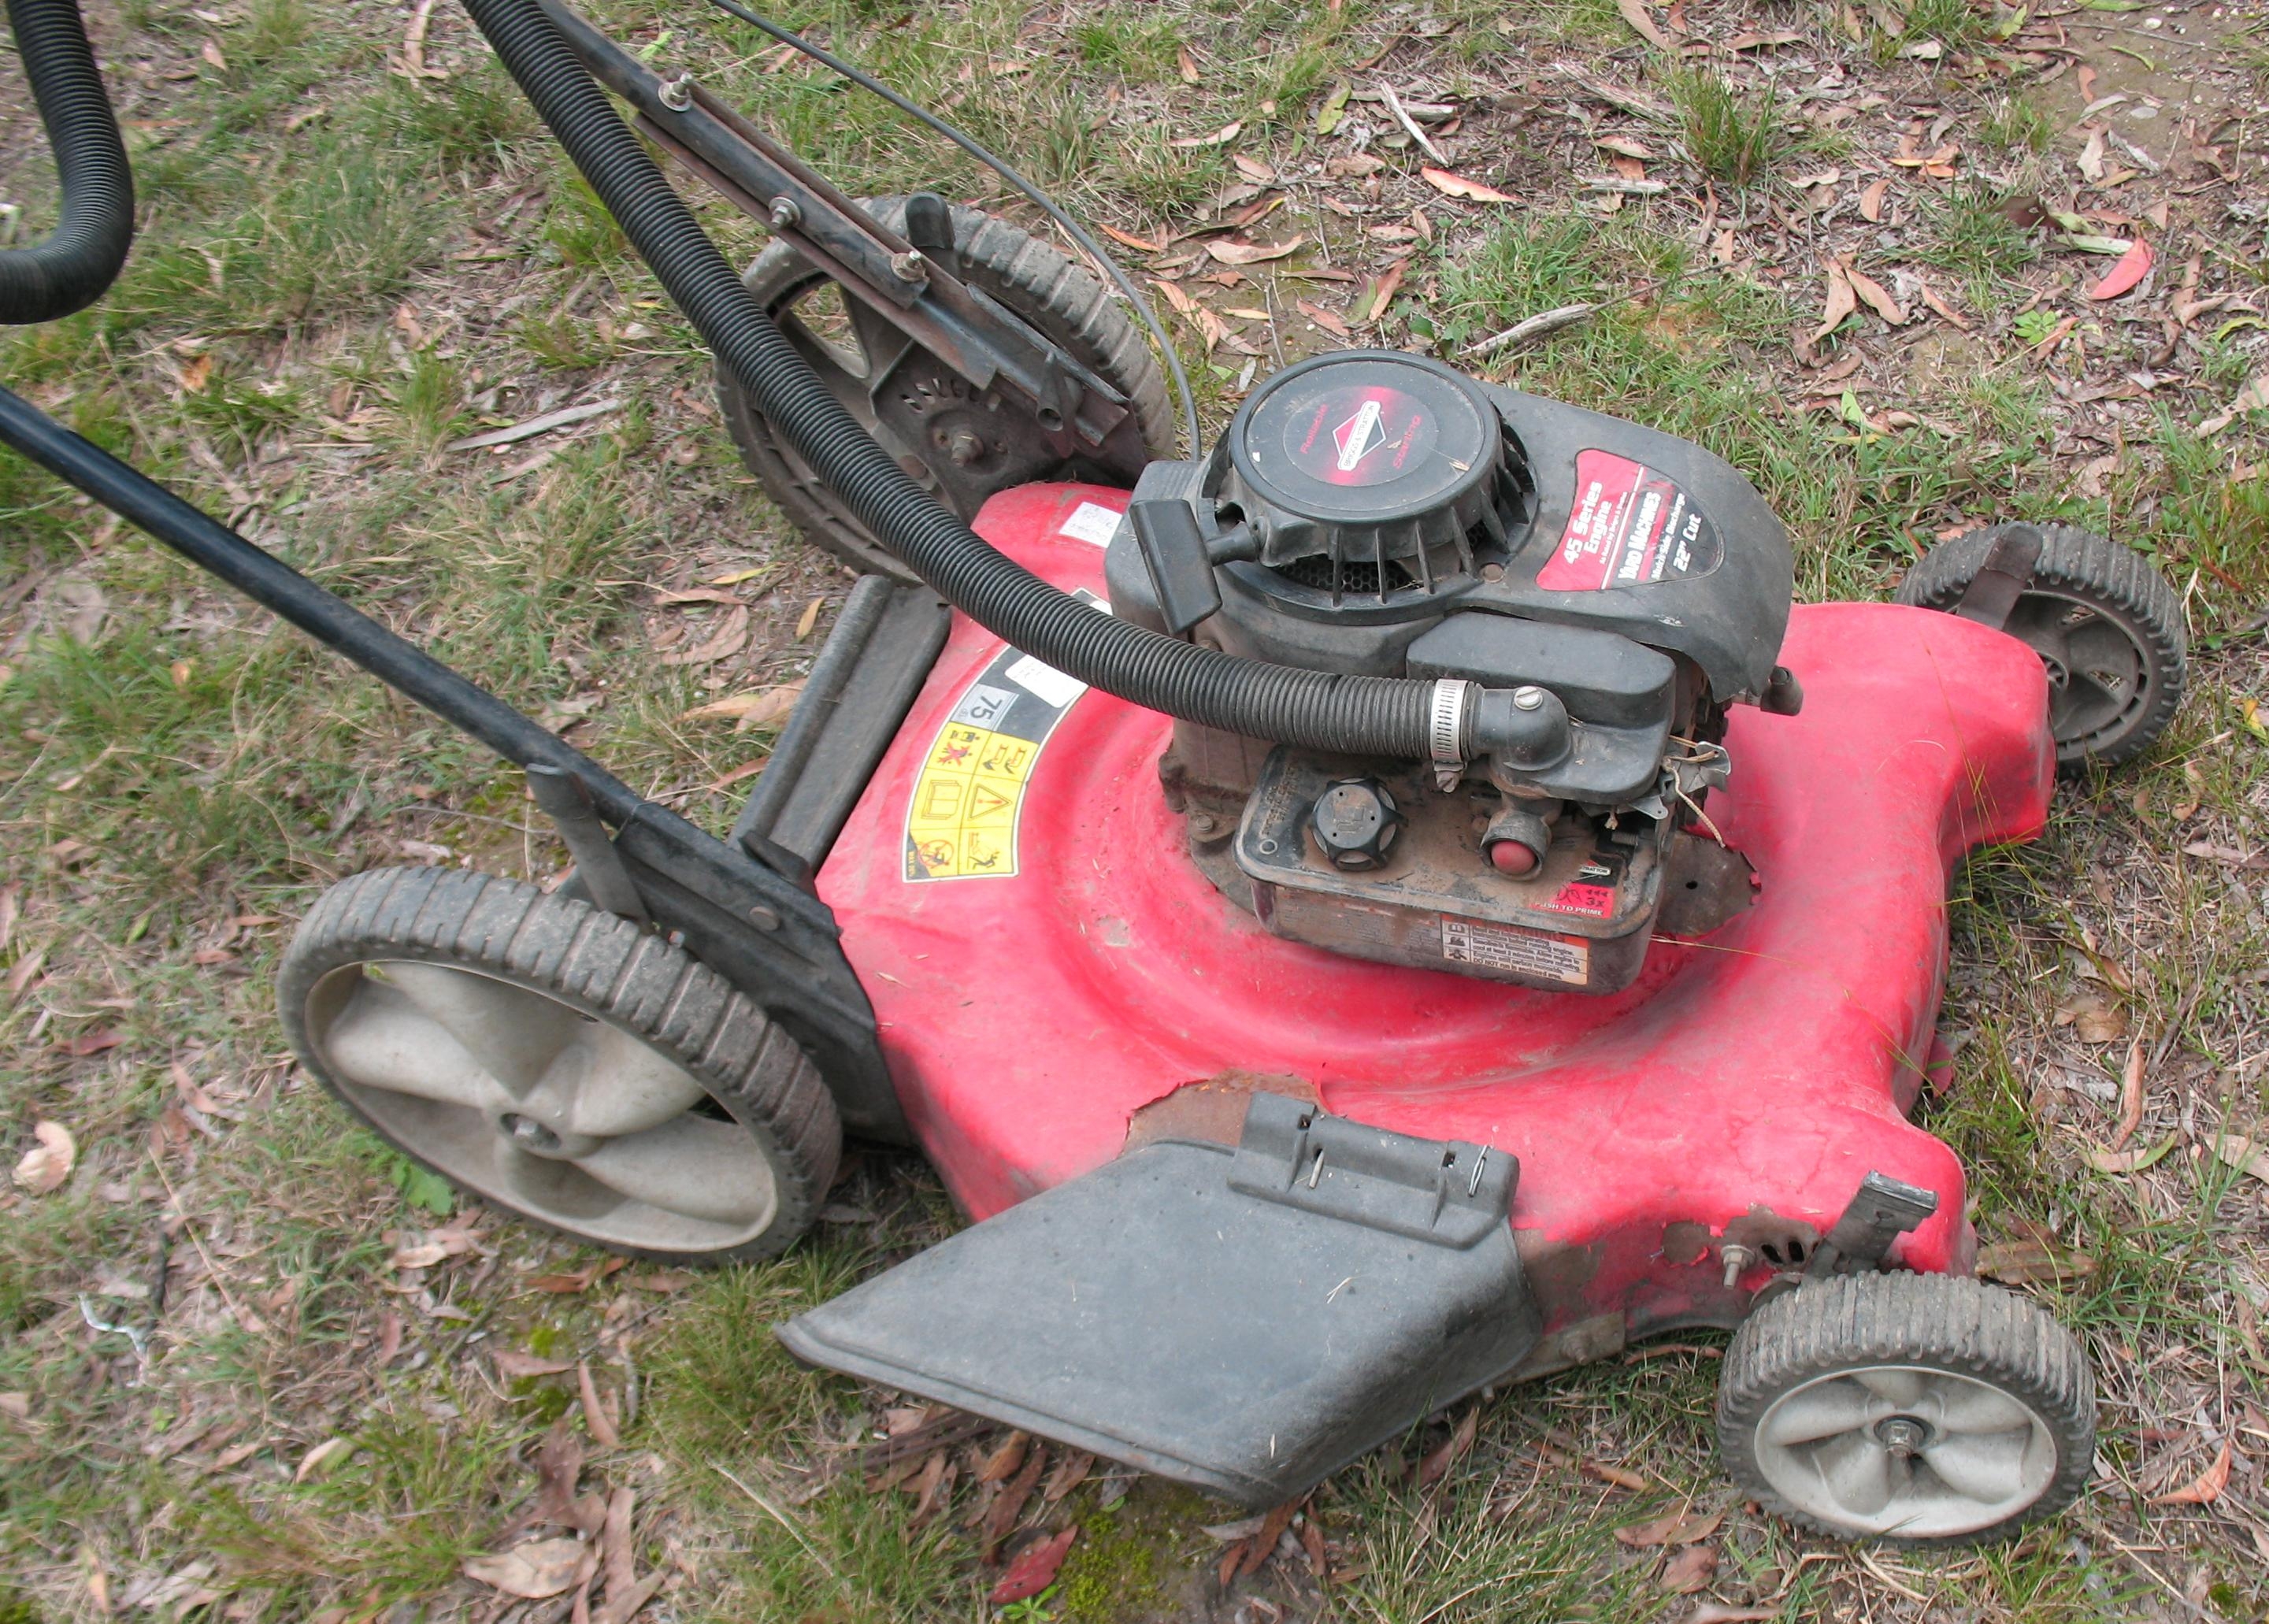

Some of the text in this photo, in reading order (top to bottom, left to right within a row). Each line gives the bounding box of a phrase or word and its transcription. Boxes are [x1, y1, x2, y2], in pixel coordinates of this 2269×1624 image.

[1299, 403, 1329, 454] Reliable
[1392, 414, 1422, 469] Starting
[1563, 480, 1604, 565] 45 Series
[1583, 500, 1613, 554] Engine
[1618, 491, 1662, 580] YARD MACHINES
[1665, 492, 1686, 535] Discharge
[1683, 514, 1702, 541] Cut
[970, 695, 1003, 720] 75
[1575, 907, 1604, 916] PRIME
